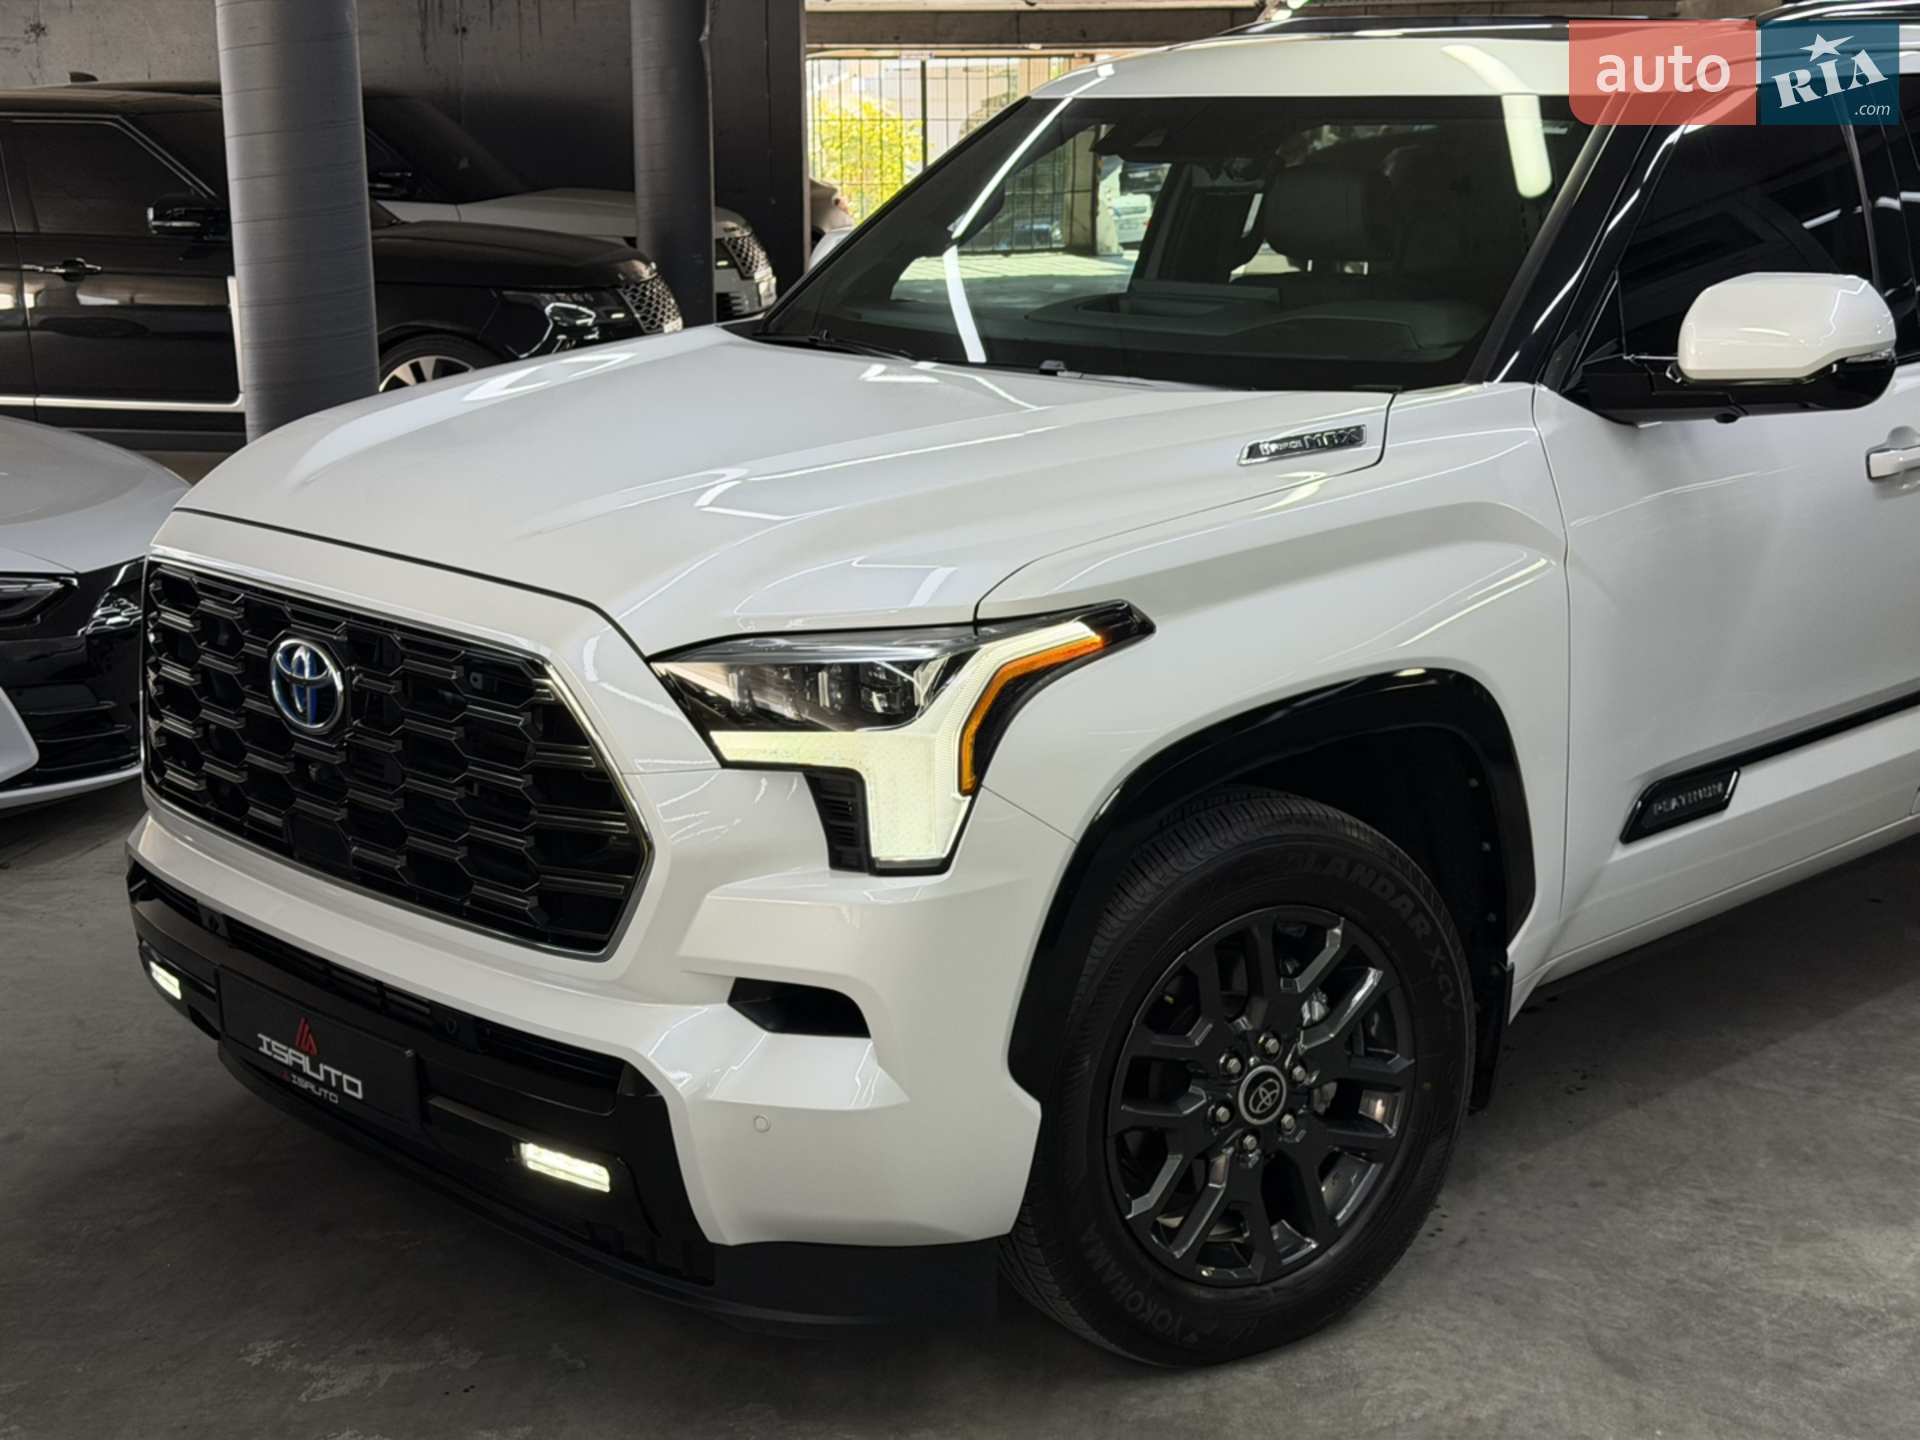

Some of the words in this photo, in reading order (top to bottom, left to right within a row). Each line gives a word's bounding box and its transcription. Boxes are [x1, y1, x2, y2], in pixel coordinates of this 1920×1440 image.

[1652, 782, 1724, 816] PLATINUM
[257, 1033, 363, 1100] ISAUTO
[1080, 1222, 1184, 1340] YOKOHAMA
